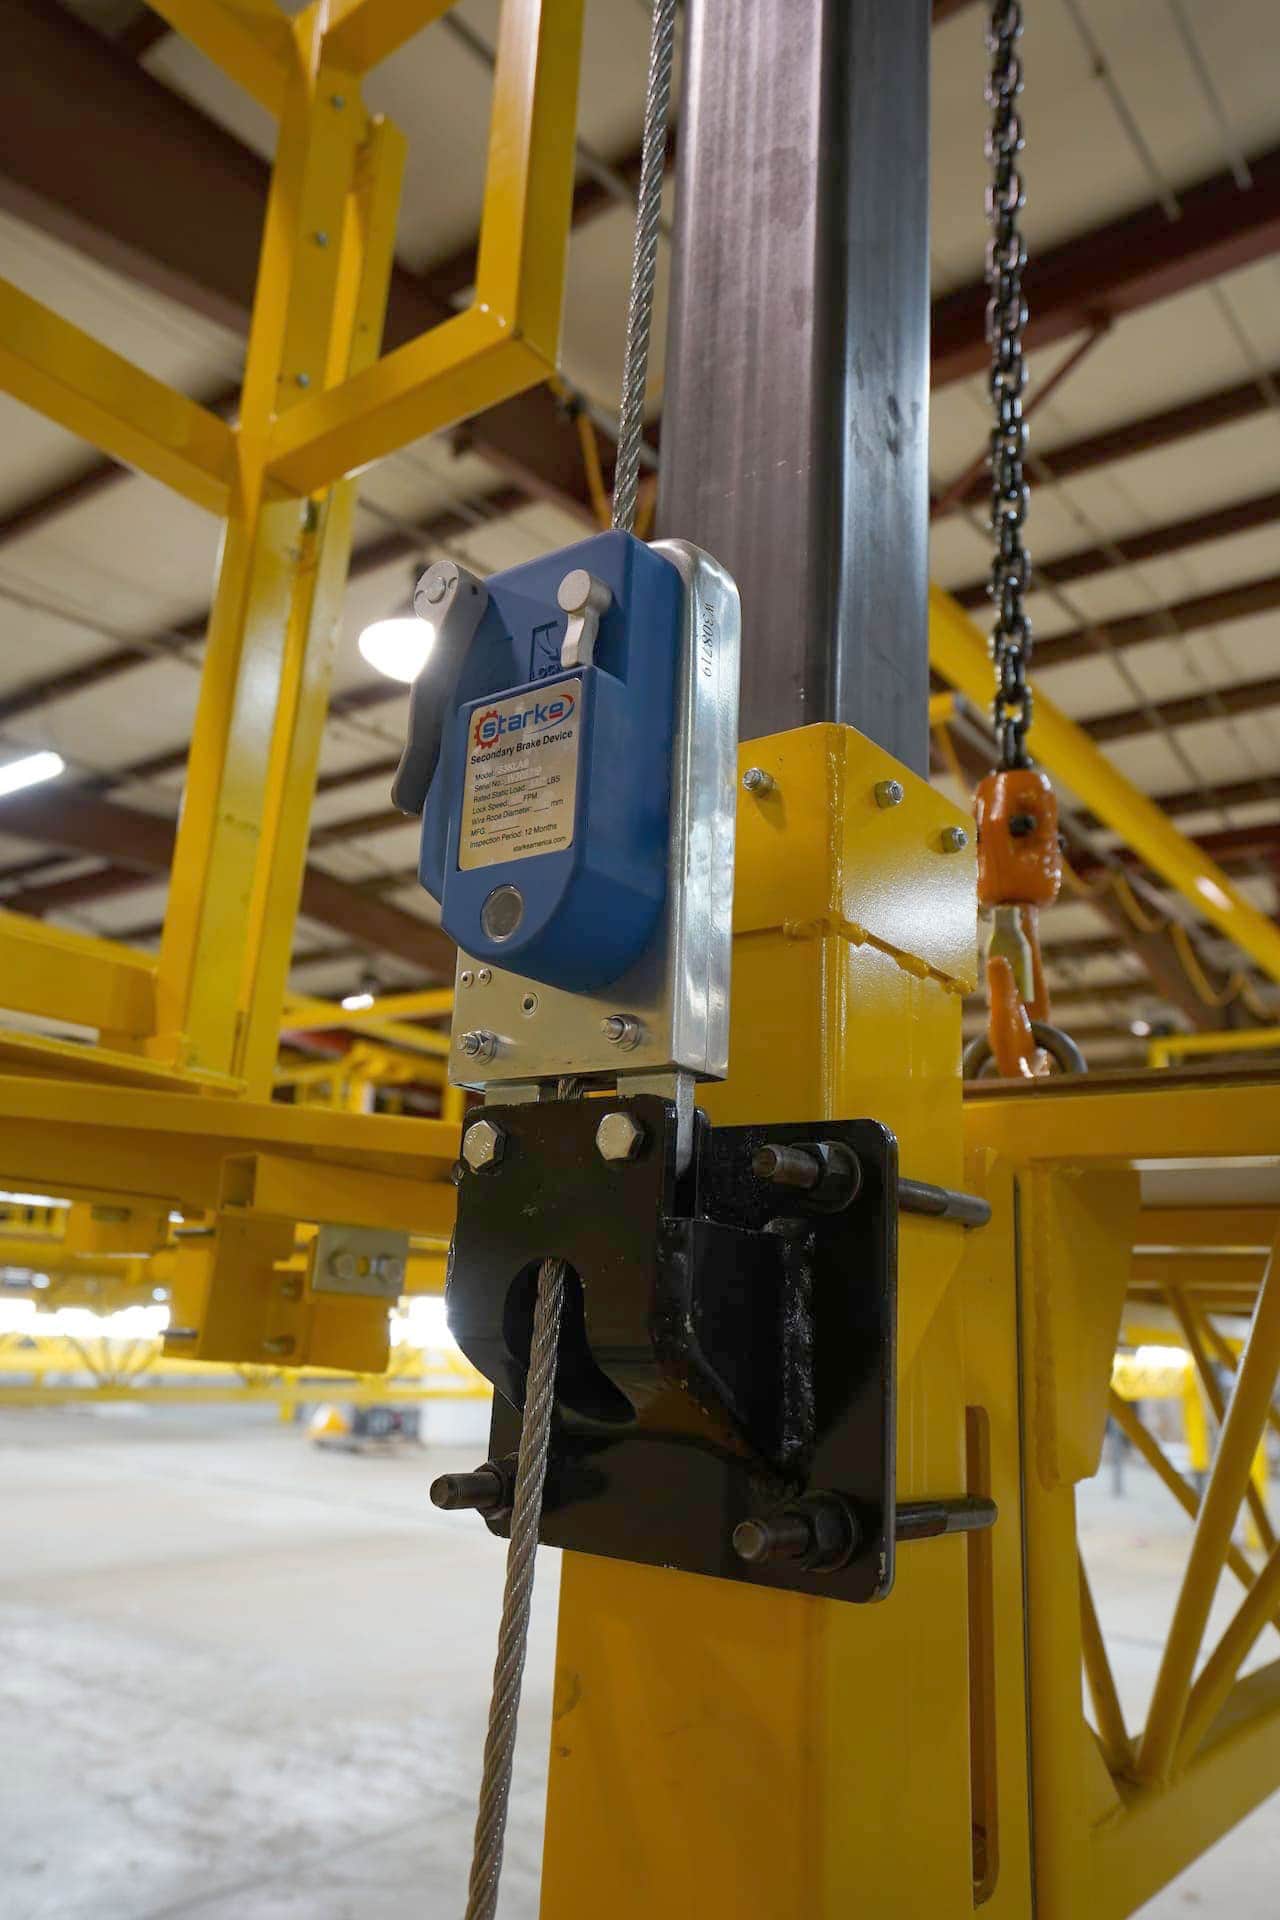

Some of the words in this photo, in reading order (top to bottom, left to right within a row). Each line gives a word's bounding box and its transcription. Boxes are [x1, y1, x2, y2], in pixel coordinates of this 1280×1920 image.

[482, 701, 564, 739] starke
[471, 746, 514, 765] Secondary
[516, 739, 541, 752] Brake
[543, 730, 573, 745] Device
[546, 775, 561, 785] LBS
[472, 805, 487, 814] Lock
[523, 792, 538, 801] FPM
[486, 812, 502, 823] Rope
[550, 799, 564, 807] mm
[525, 828, 532, 836] 12
[533, 823, 558, 833] Months
